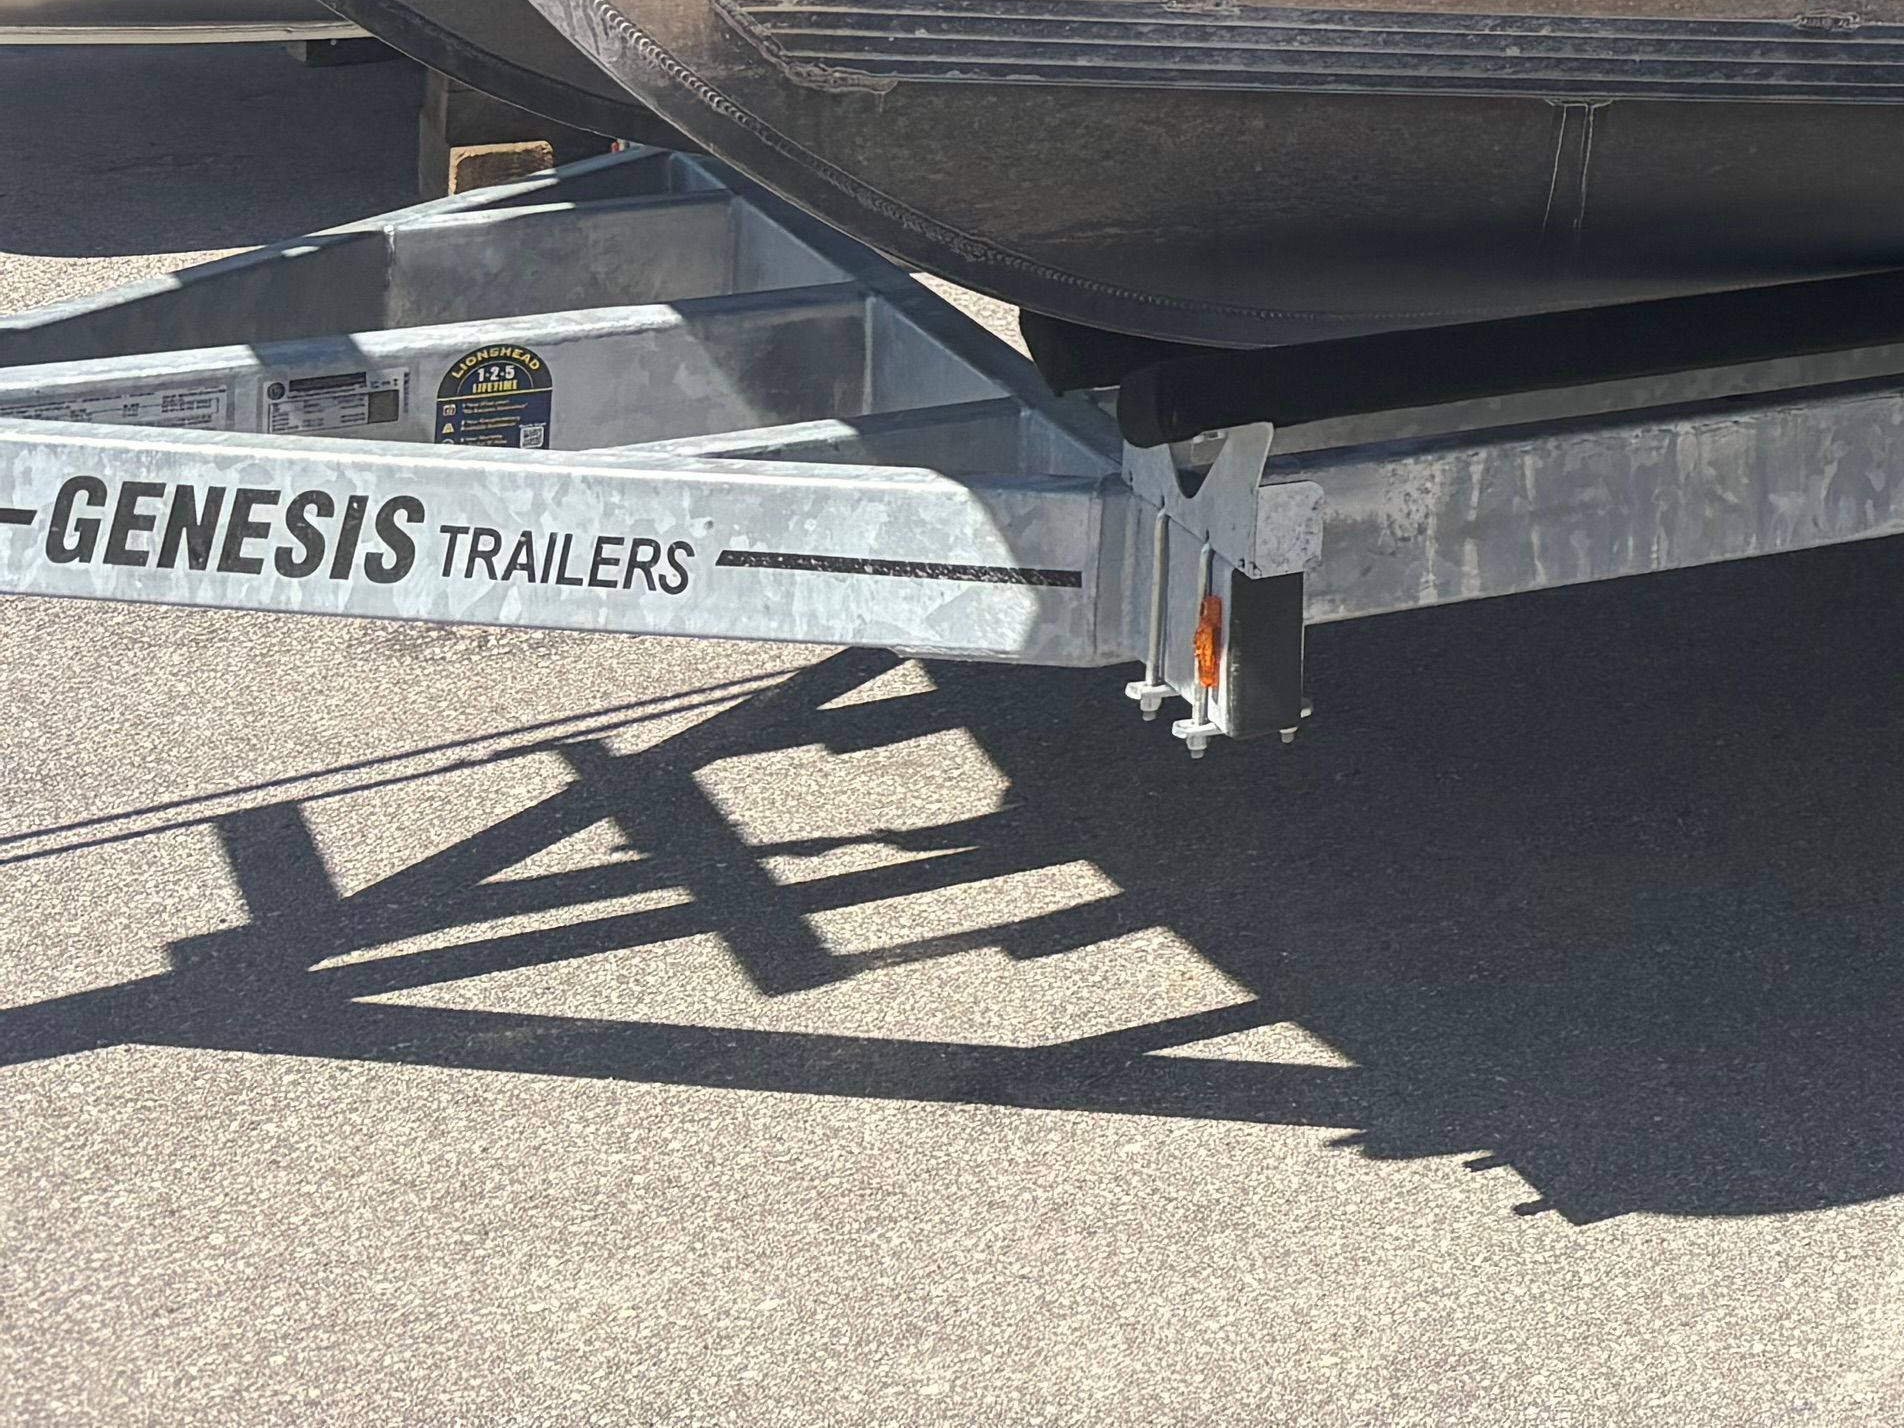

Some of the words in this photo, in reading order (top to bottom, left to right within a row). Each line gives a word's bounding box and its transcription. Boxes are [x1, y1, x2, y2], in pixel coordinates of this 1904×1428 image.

[451, 346, 541, 379] LIONSHEAD
[472, 378, 518, 394] LIFETIME
[45, 475, 425, 584] GENESIS
[440, 525, 695, 595] TRAILERS
